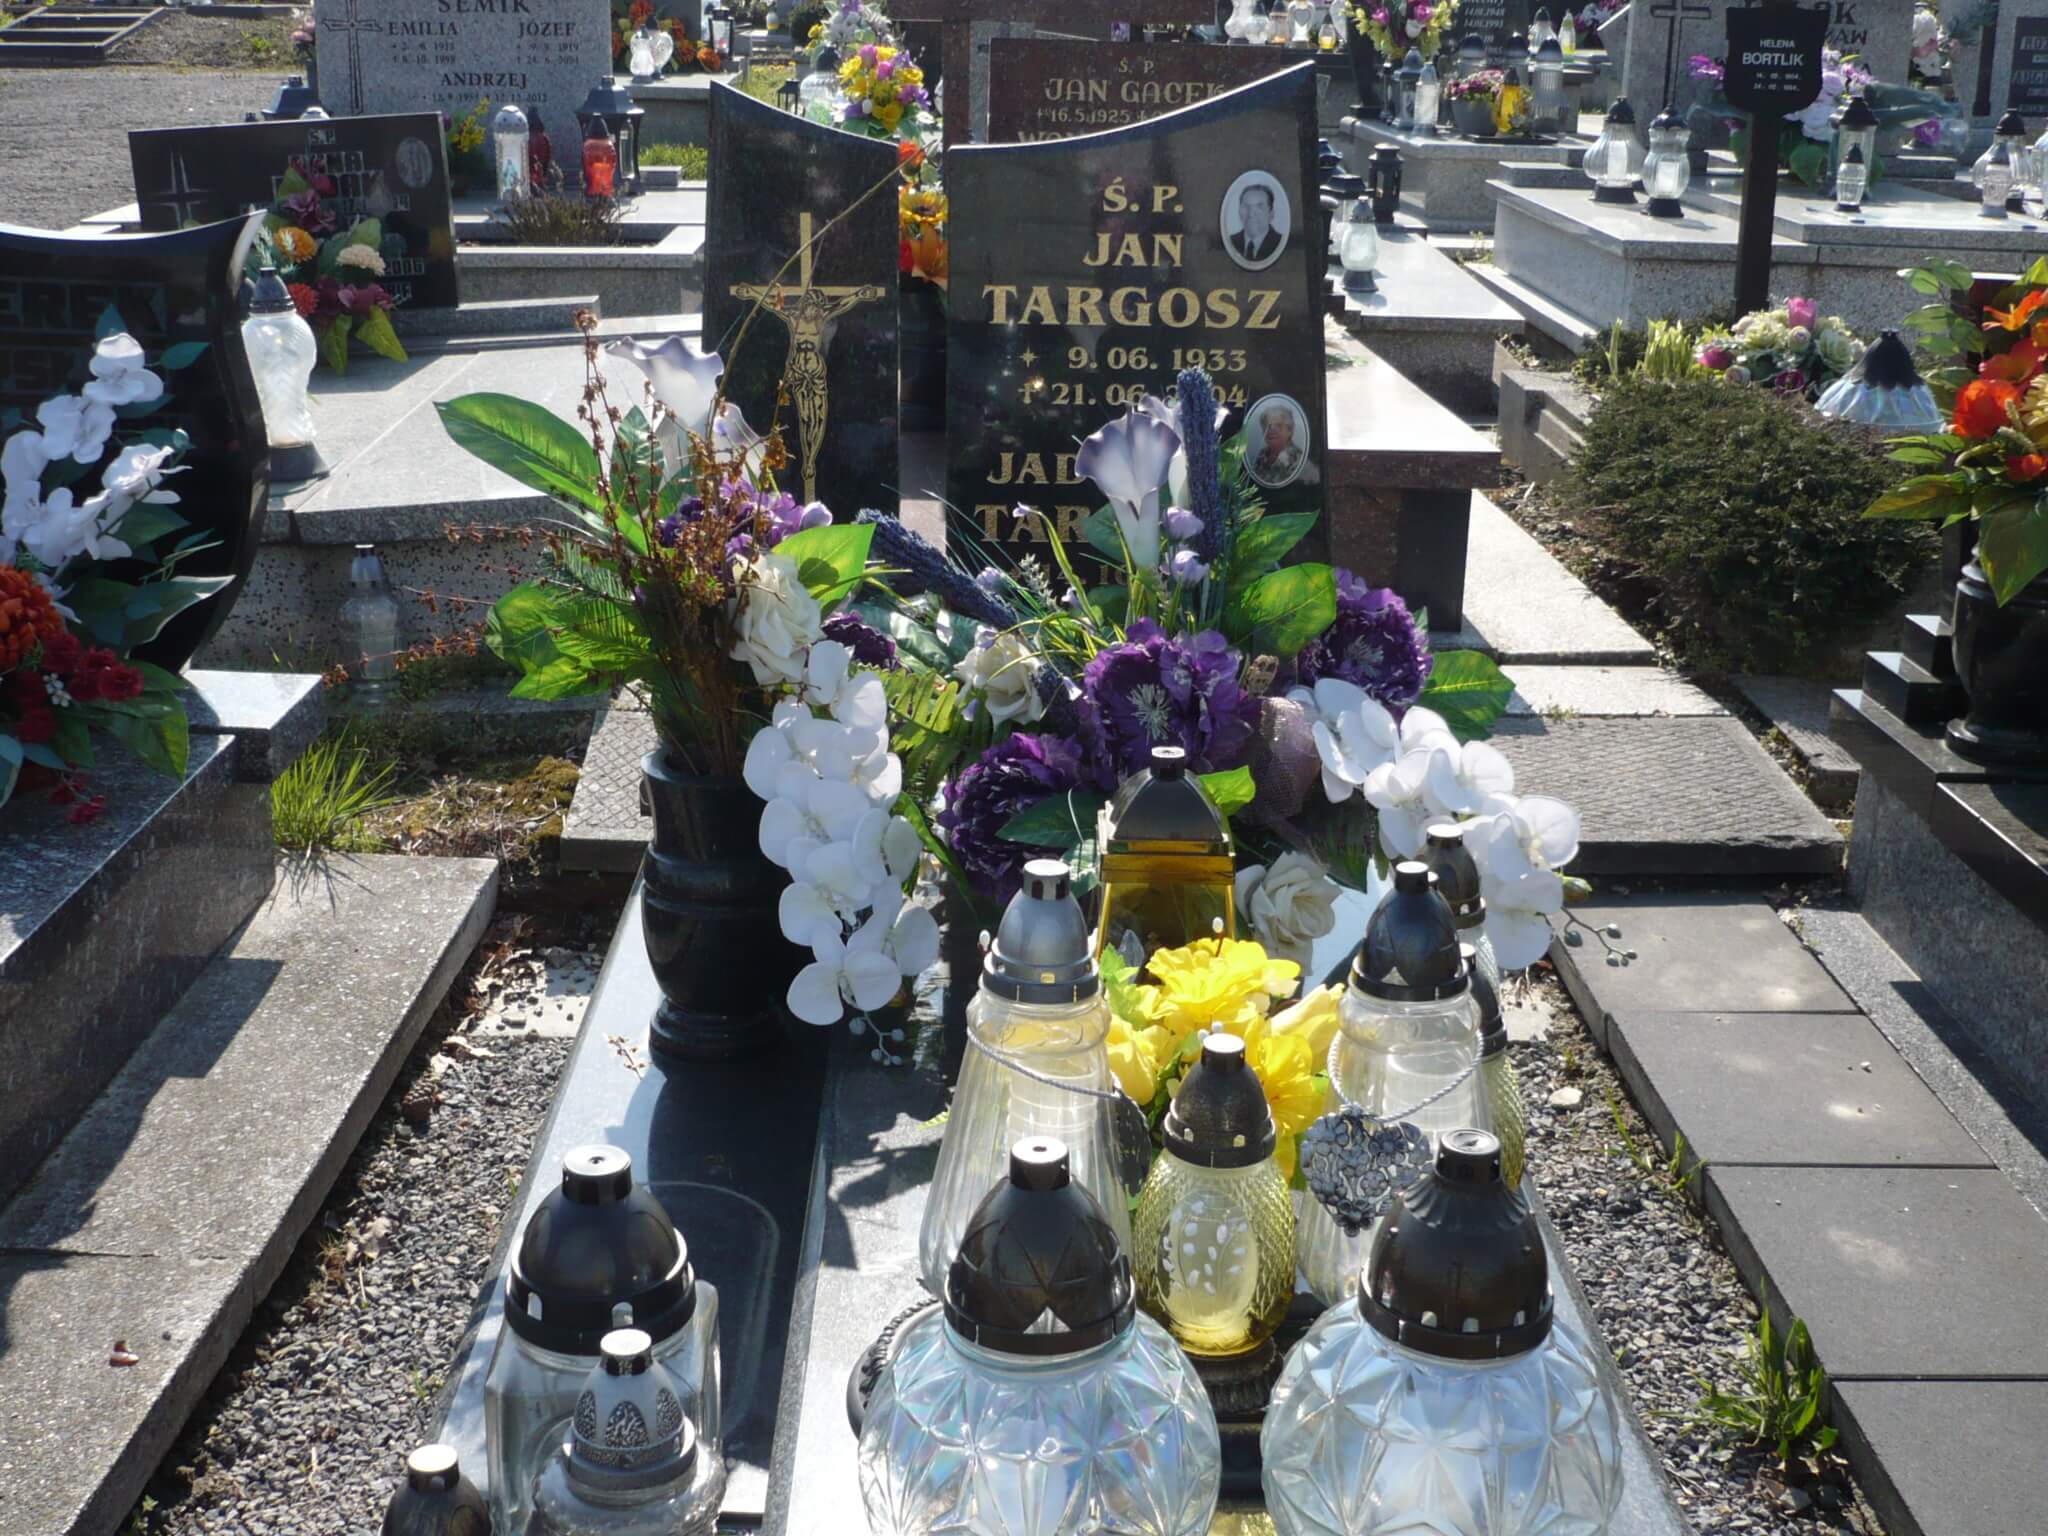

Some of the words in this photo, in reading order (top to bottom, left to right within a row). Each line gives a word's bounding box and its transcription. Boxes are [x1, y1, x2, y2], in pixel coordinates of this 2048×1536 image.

[438, 0, 530, 14] SEMIK
[388, 21, 459, 36] EMILIA
[518, 18, 577, 39] JÓZEF
[1760, 39, 1796, 49] HELENA
[1118, 57, 1133, 74] Ś.
[1143, 59, 1156, 74] P.
[1742, 52, 1805, 67] BORTLIK
[440, 72, 528, 89] ANDRZEJ
[1044, 78, 1108, 102] JAN
[1120, 80, 1226, 105] GACEK
[1103, 176, 1140, 213] Ś.
[1152, 185, 1185, 214] P.
[1082, 232, 1185, 268] JAN
[981, 284, 1282, 329] TARGOSZ
[1068, 346, 1098, 370] 9.
[1106, 347, 1158, 370] 06.
[1171, 348, 1248, 372] 1933
[1051, 383, 1096, 406] 21.
[1165, 384, 1248, 407] 04
